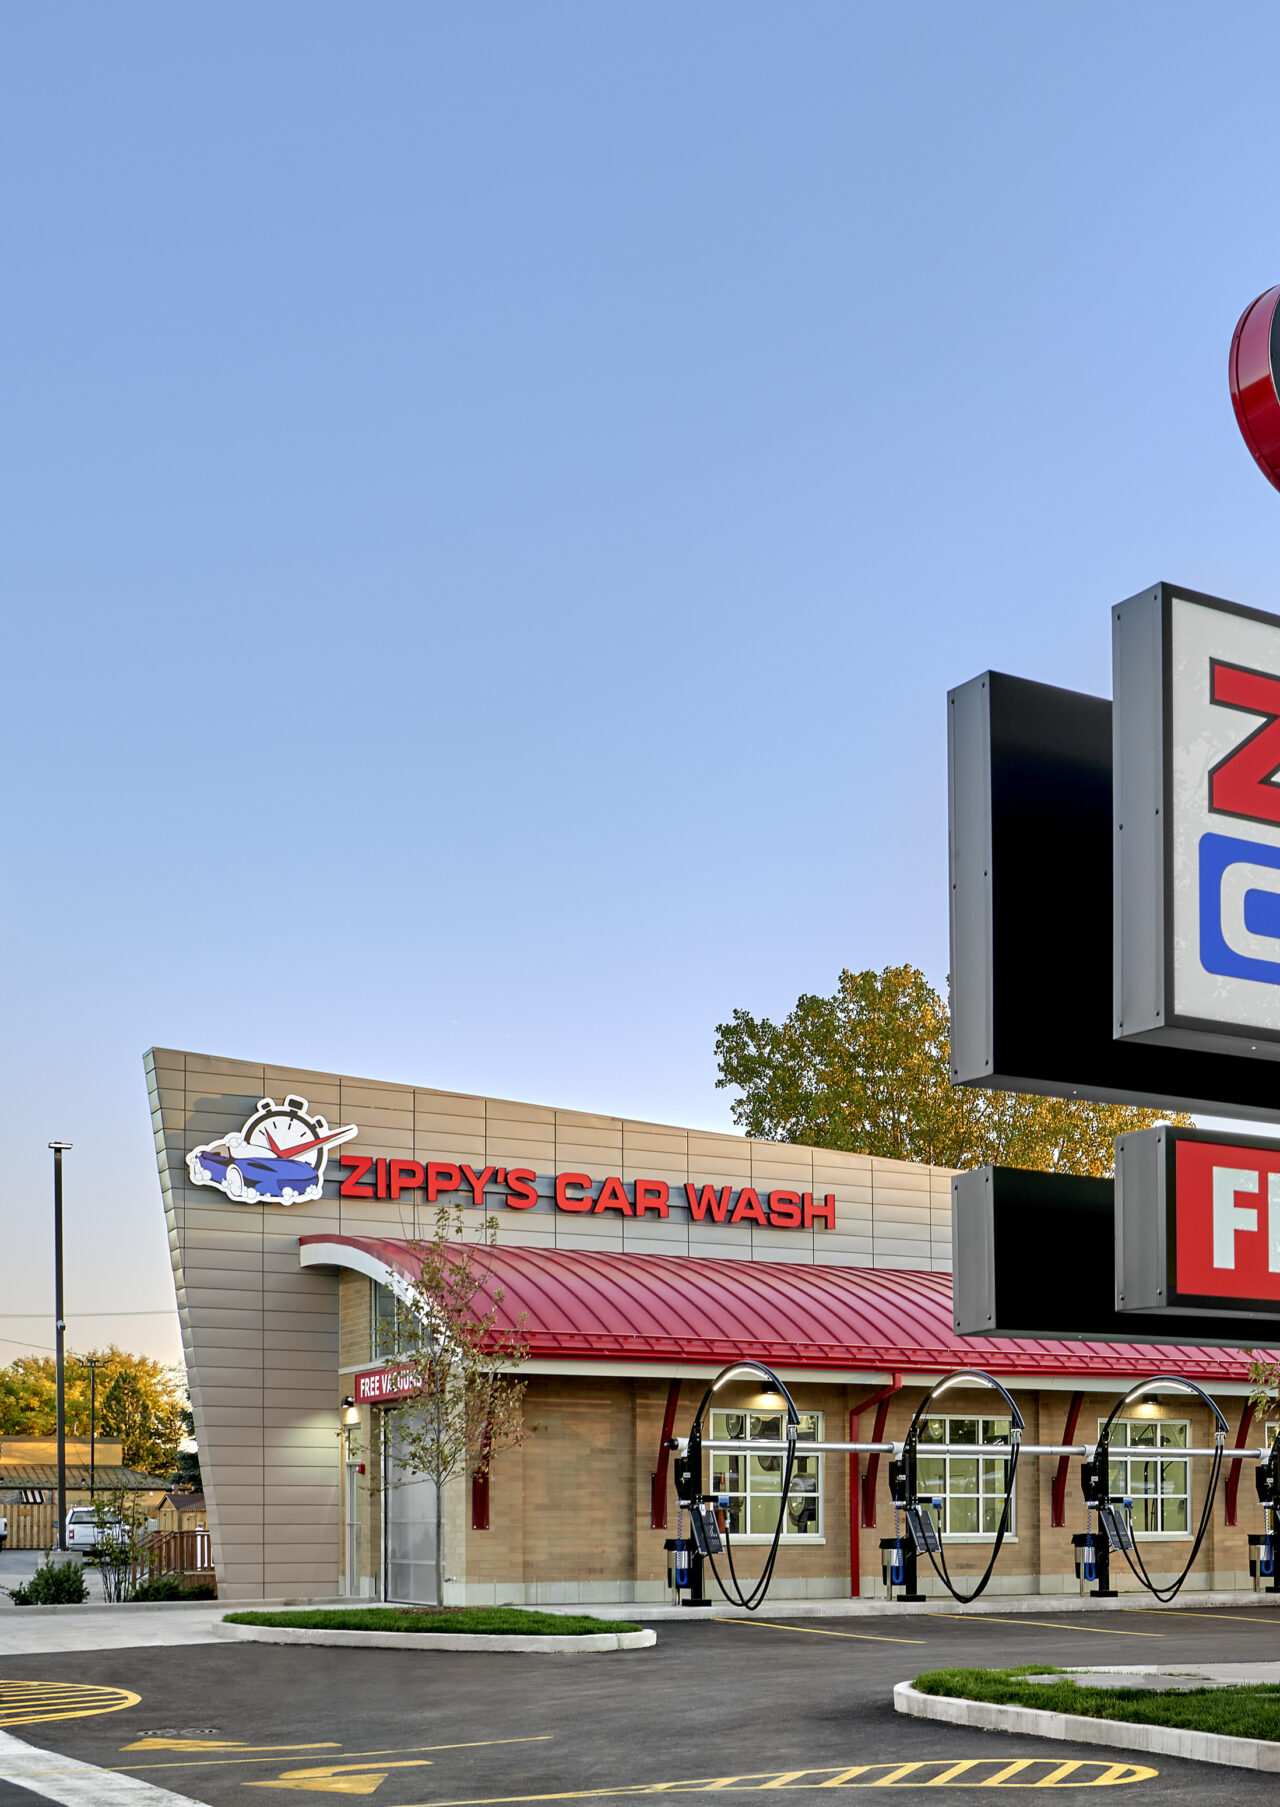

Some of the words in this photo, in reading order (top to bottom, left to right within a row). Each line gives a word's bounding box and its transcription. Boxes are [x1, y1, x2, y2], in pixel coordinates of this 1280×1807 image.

[340, 1155, 538, 1209] ZIPPY'S
[556, 1172, 670, 1218] CAR
[685, 1182, 836, 1230] WASH
[360, 1375, 380, 1398] FREE
